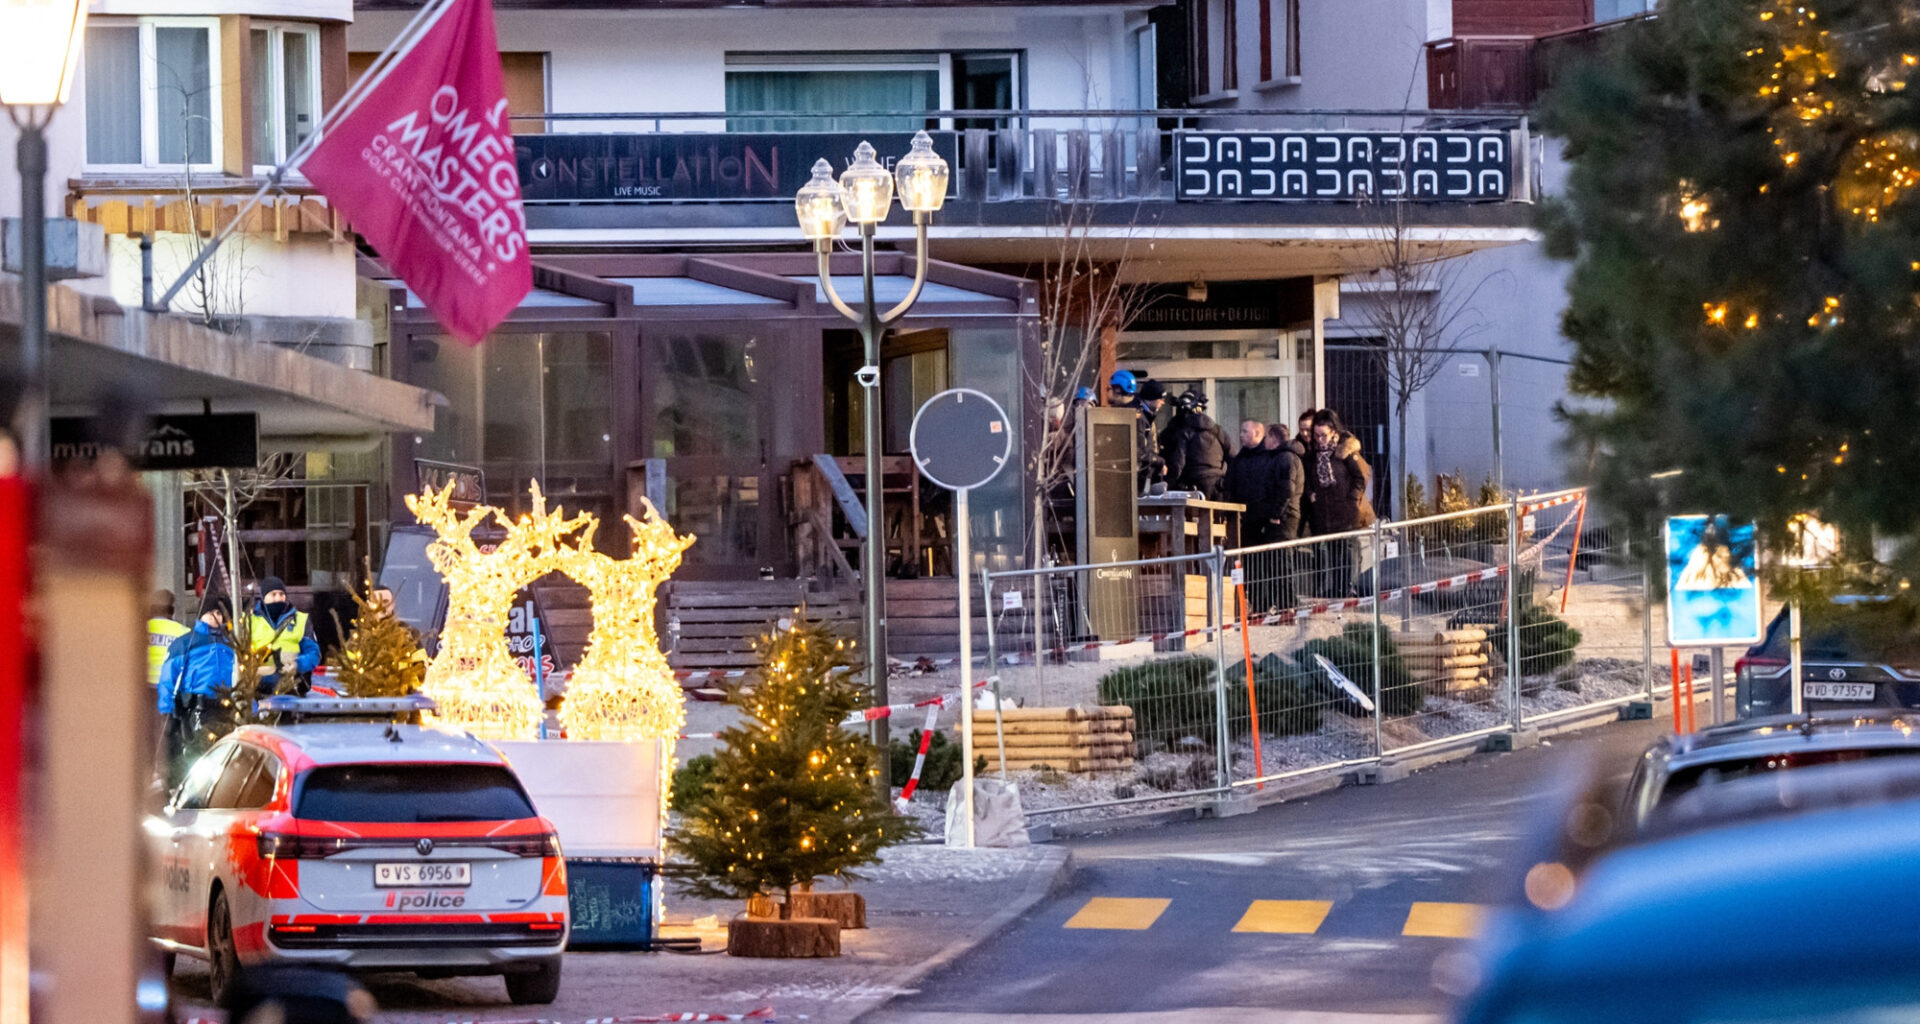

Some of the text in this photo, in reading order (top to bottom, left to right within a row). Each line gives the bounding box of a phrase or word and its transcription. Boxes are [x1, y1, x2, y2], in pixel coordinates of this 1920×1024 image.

[361, 147, 392, 177] GOLF
[431, 85, 526, 237] OMEGA
[387, 110, 524, 262] MASTERS
[614, 186, 661, 196] LIVE MUSIC
[419, 190, 483, 261] MONTANA
[1815, 684, 1865, 697] VD 97357
[395, 866, 452, 881] VS 6956
[398, 891, 466, 912] police
